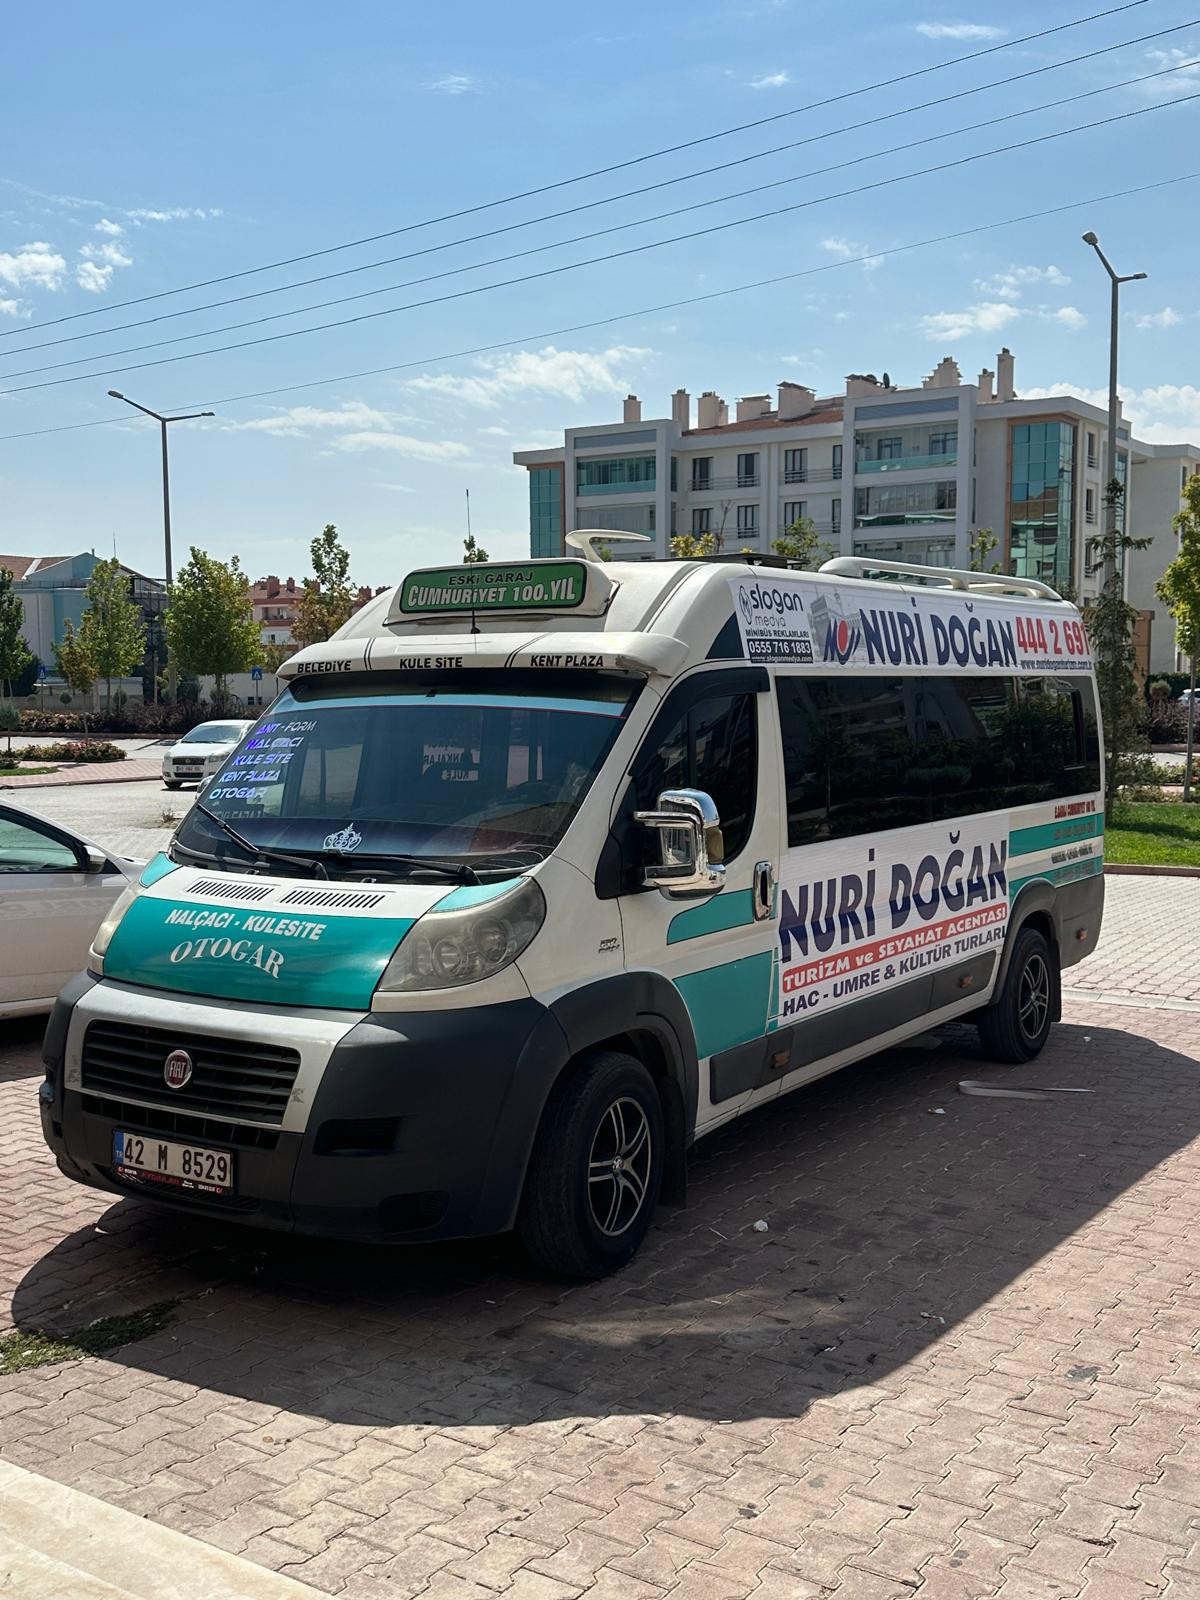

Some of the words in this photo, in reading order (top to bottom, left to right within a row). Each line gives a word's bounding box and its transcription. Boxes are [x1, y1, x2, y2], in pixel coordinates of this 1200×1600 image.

[484, 572, 533, 583] GARAJ
[750, 583, 804, 614] slogan
[755, 615, 786, 628] medya
[773, 630, 810, 638] REKLAMLARI
[859, 597, 929, 666] NURİ
[930, 602, 1018, 668] DOĞAN
[1015, 616, 1048, 654] 444
[1048, 619, 1063, 655] 2
[1062, 620, 1091, 656] 691
[749, 641, 772, 653] 0555
[772, 641, 790, 653] 716
[790, 642, 811, 653] 1883
[400, 658, 431, 669] KULE
[530, 655, 562, 667] KENT
[564, 655, 603, 667] PLAZA
[284, 720, 317, 732] FORM
[231, 753, 264, 766] KULE
[218, 770, 247, 783] KENT
[244, 769, 280, 781] PLAZA
[209, 787, 267, 800] OTOGAR
[778, 847, 877, 964] NURİ
[889, 829, 1008, 930] DOĞAN
[164, 909, 235, 931] NALÇACI
[783, 956, 850, 991] TURİZM
[855, 951, 874, 965] ve
[878, 926, 943, 960] SEYAHAT
[946, 905, 1008, 937] ACENTASI
[170, 937, 285, 979] OTOGAR
[782, 989, 820, 1017] HAC
[832, 967, 881, 998] UMRE
[883, 962, 896, 980] &
[900, 942, 952, 975] KÜLTÜR
[954, 925, 1008, 954] TURLARI
[169, 1060, 187, 1079] FIAT
[124, 1138, 145, 1165] 42
[158, 1144, 168, 1171] M
[182, 1149, 228, 1182] 8529
